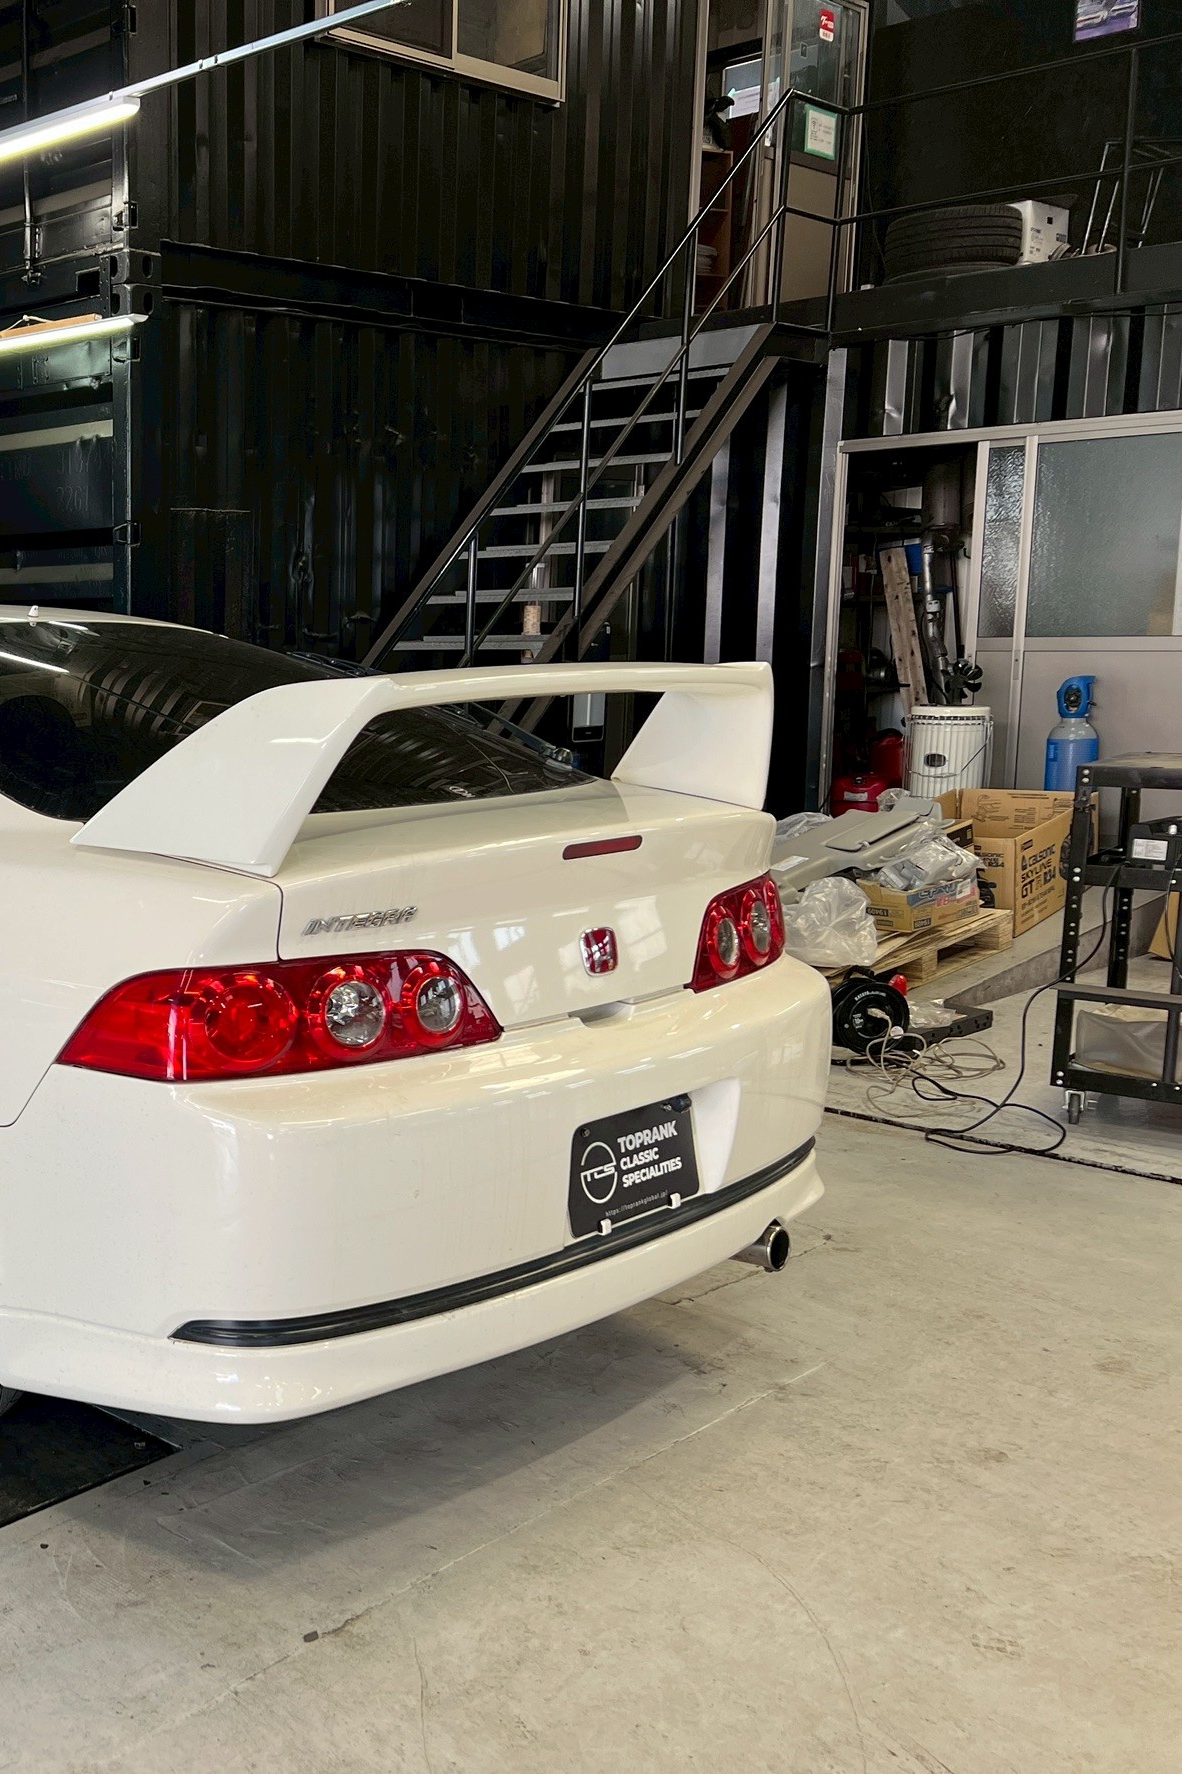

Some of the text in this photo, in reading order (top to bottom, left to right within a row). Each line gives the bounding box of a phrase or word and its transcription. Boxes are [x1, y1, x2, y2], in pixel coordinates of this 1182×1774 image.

[301, 905, 418, 936] INTEGRA
[617, 1120, 678, 1153] TOPRANK
[581, 1162, 617, 1182] TCS
[620, 1147, 659, 1170] CLASSIC
[622, 1157, 683, 1188] SPECIALITIES
